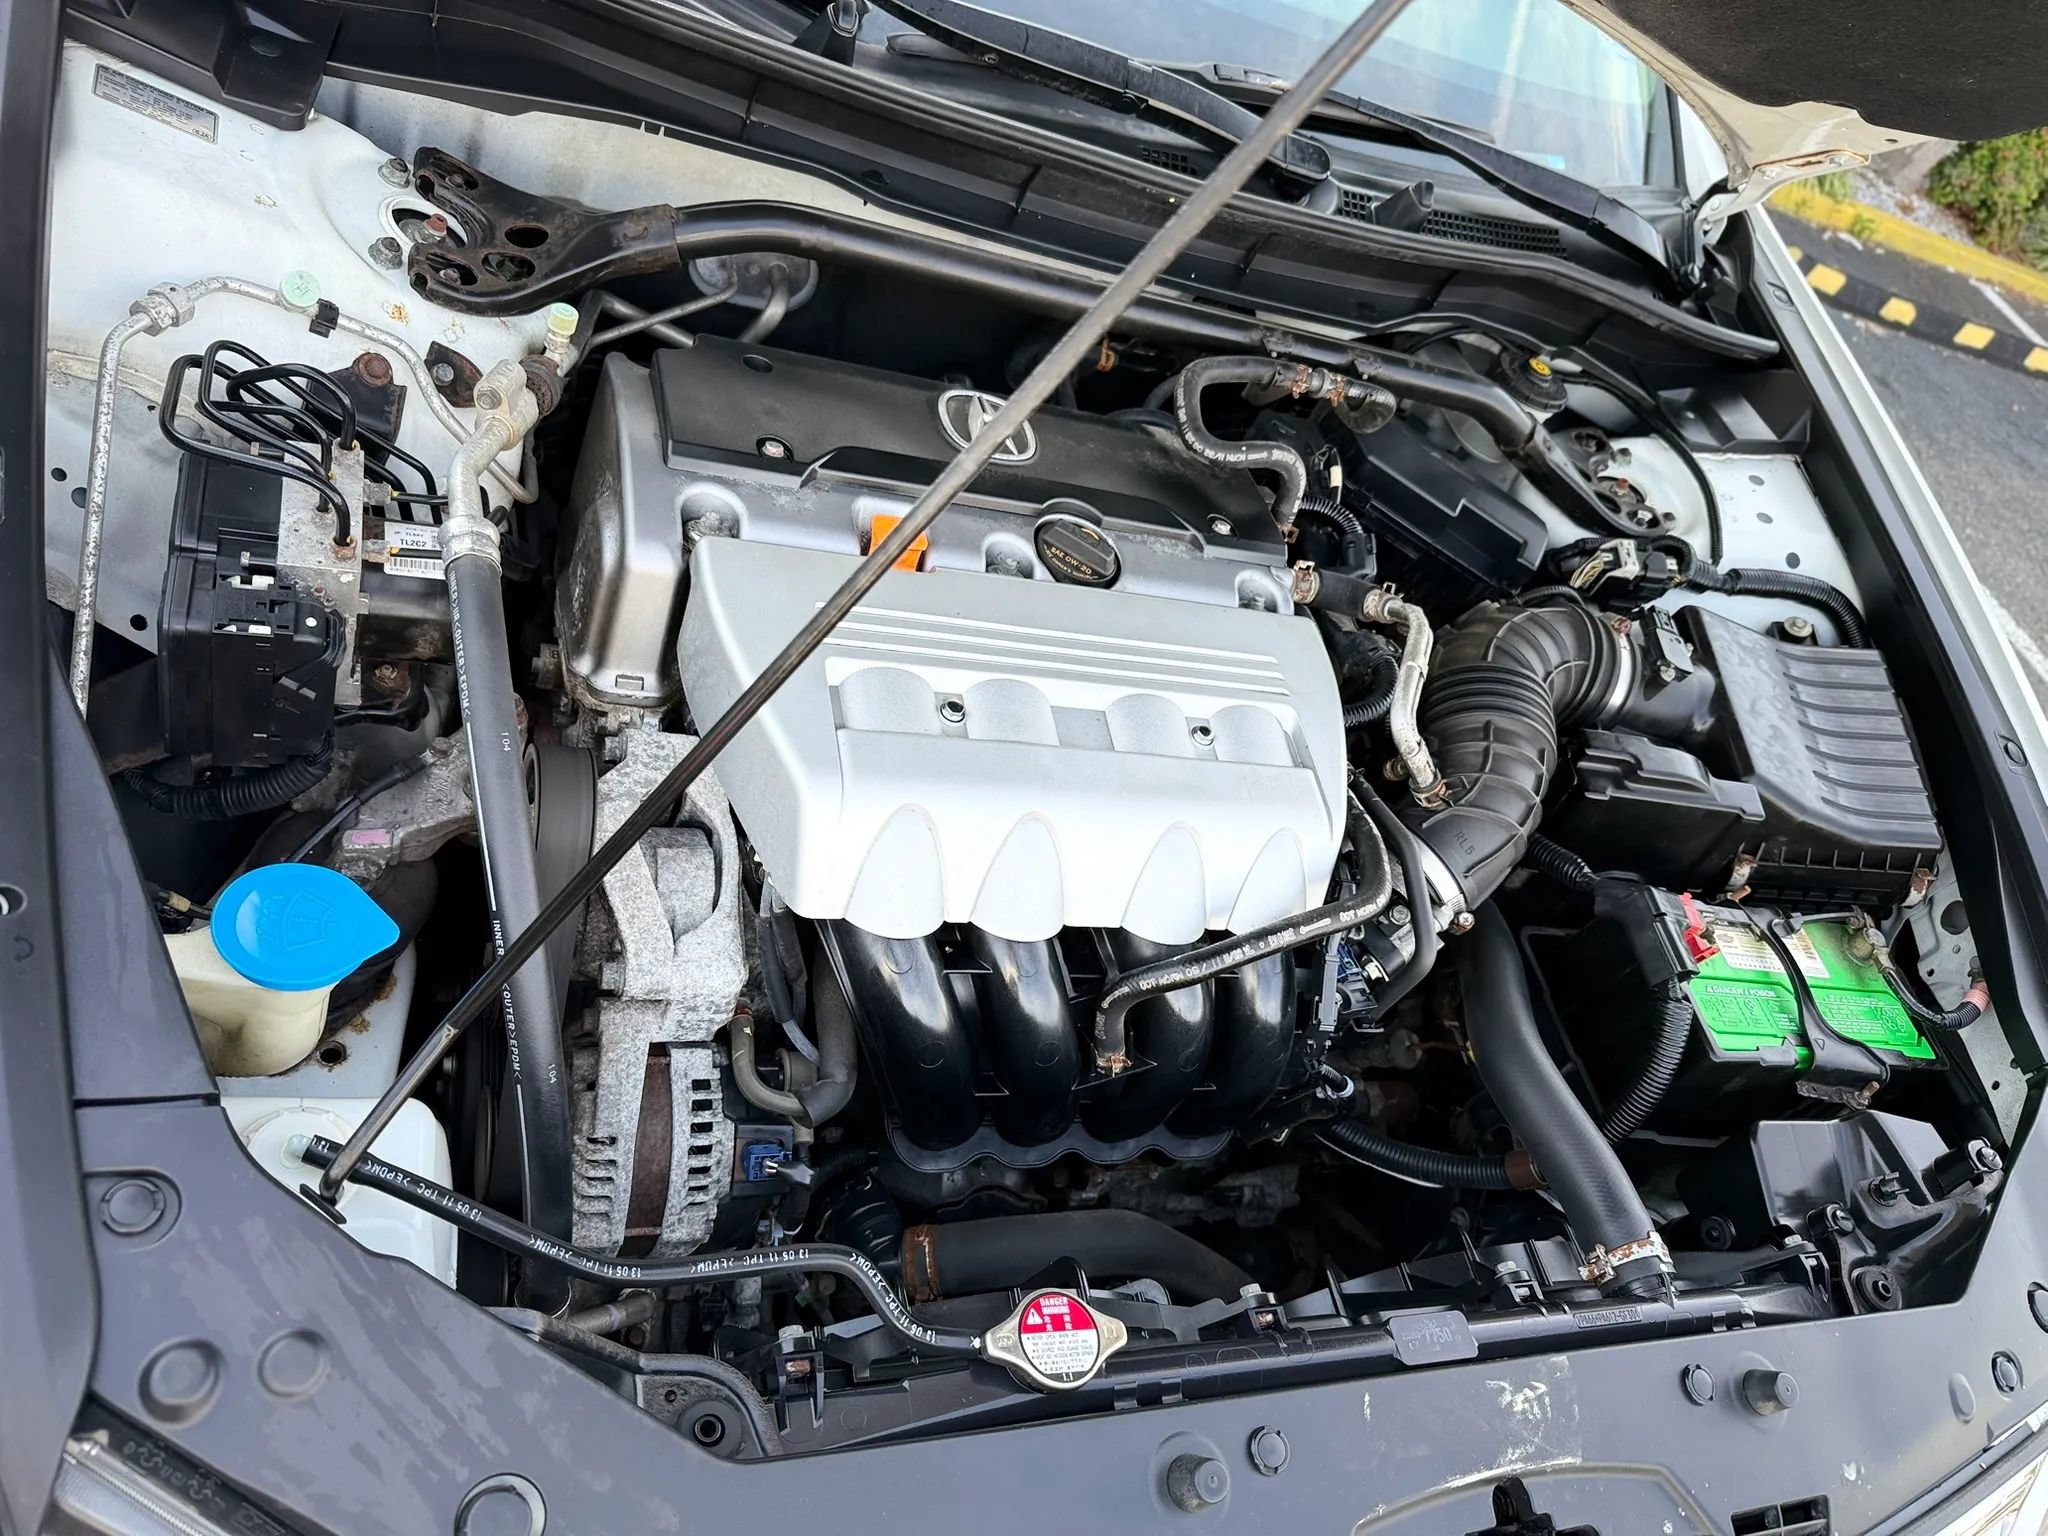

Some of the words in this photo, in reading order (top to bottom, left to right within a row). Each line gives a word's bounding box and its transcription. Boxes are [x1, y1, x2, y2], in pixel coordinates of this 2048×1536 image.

[399, 538, 427, 548] TL2C2
[417, 1183, 438, 1200] TPC
[1039, 1296, 1069, 1306] DANGER
